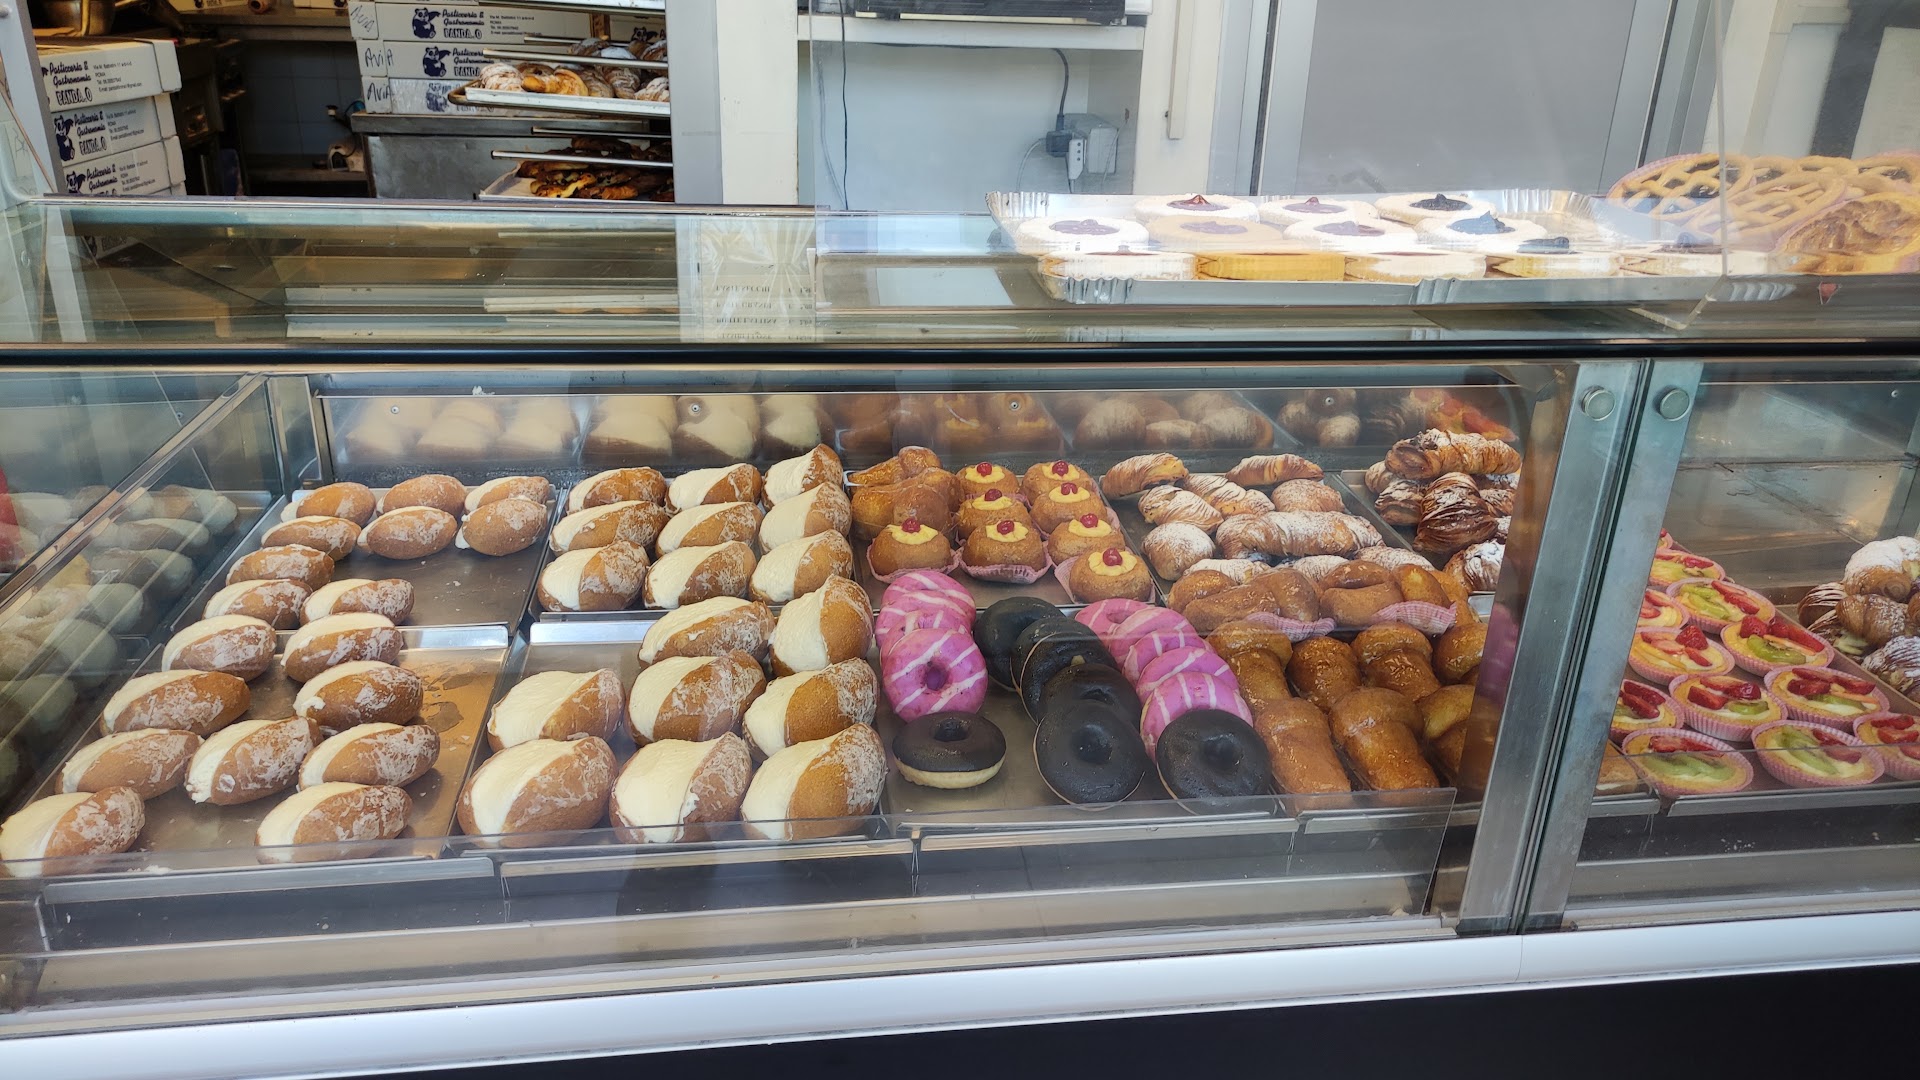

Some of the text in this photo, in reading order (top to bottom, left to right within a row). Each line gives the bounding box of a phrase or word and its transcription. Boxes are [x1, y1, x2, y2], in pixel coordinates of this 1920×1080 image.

[442, 9, 478, 18] Pasticceria
[452, 48, 483, 56] Pasticceri
[50, 62, 82, 76] Pasticceria
[454, 67, 480, 76] PANDA
[53, 75, 92, 88] Gastronomia
[74, 112, 99, 126] Pasticceria
[76, 123, 105, 138] Gastronomia
[87, 167, 111, 180] Pasticceria
[89, 176, 118, 190] Gastronomia
